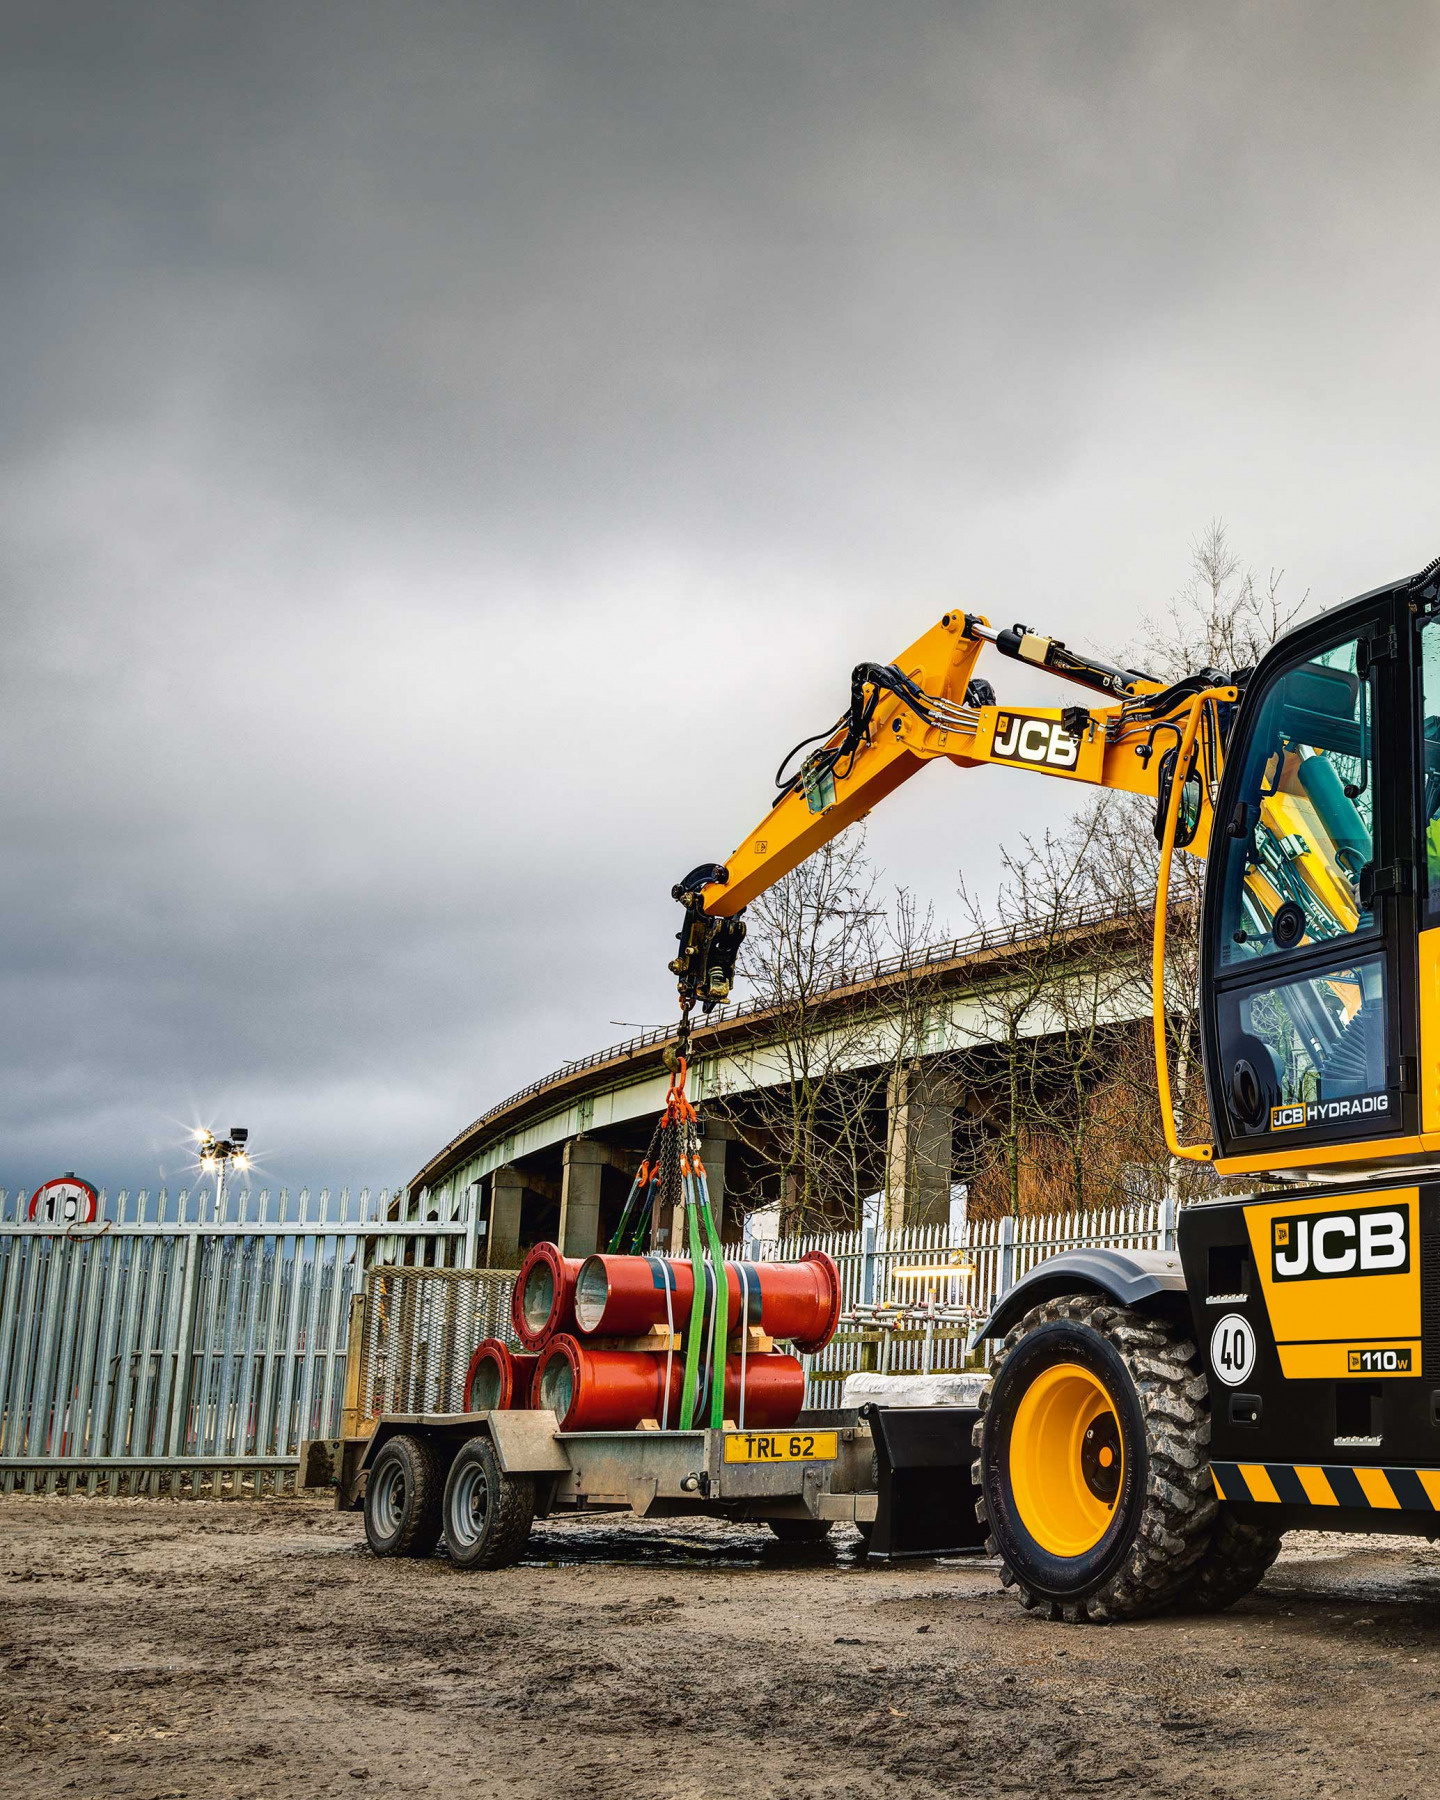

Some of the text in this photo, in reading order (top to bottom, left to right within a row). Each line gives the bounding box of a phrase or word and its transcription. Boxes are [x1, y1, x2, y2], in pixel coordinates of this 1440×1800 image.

[994, 717, 1078, 766] JCB
[1273, 1094, 1389, 1126] JCB HYDRADIG
[1275, 1211, 1407, 1276] JCB
[1220, 1328, 1245, 1371] 40
[744, 1436, 814, 1458] TRL 62
